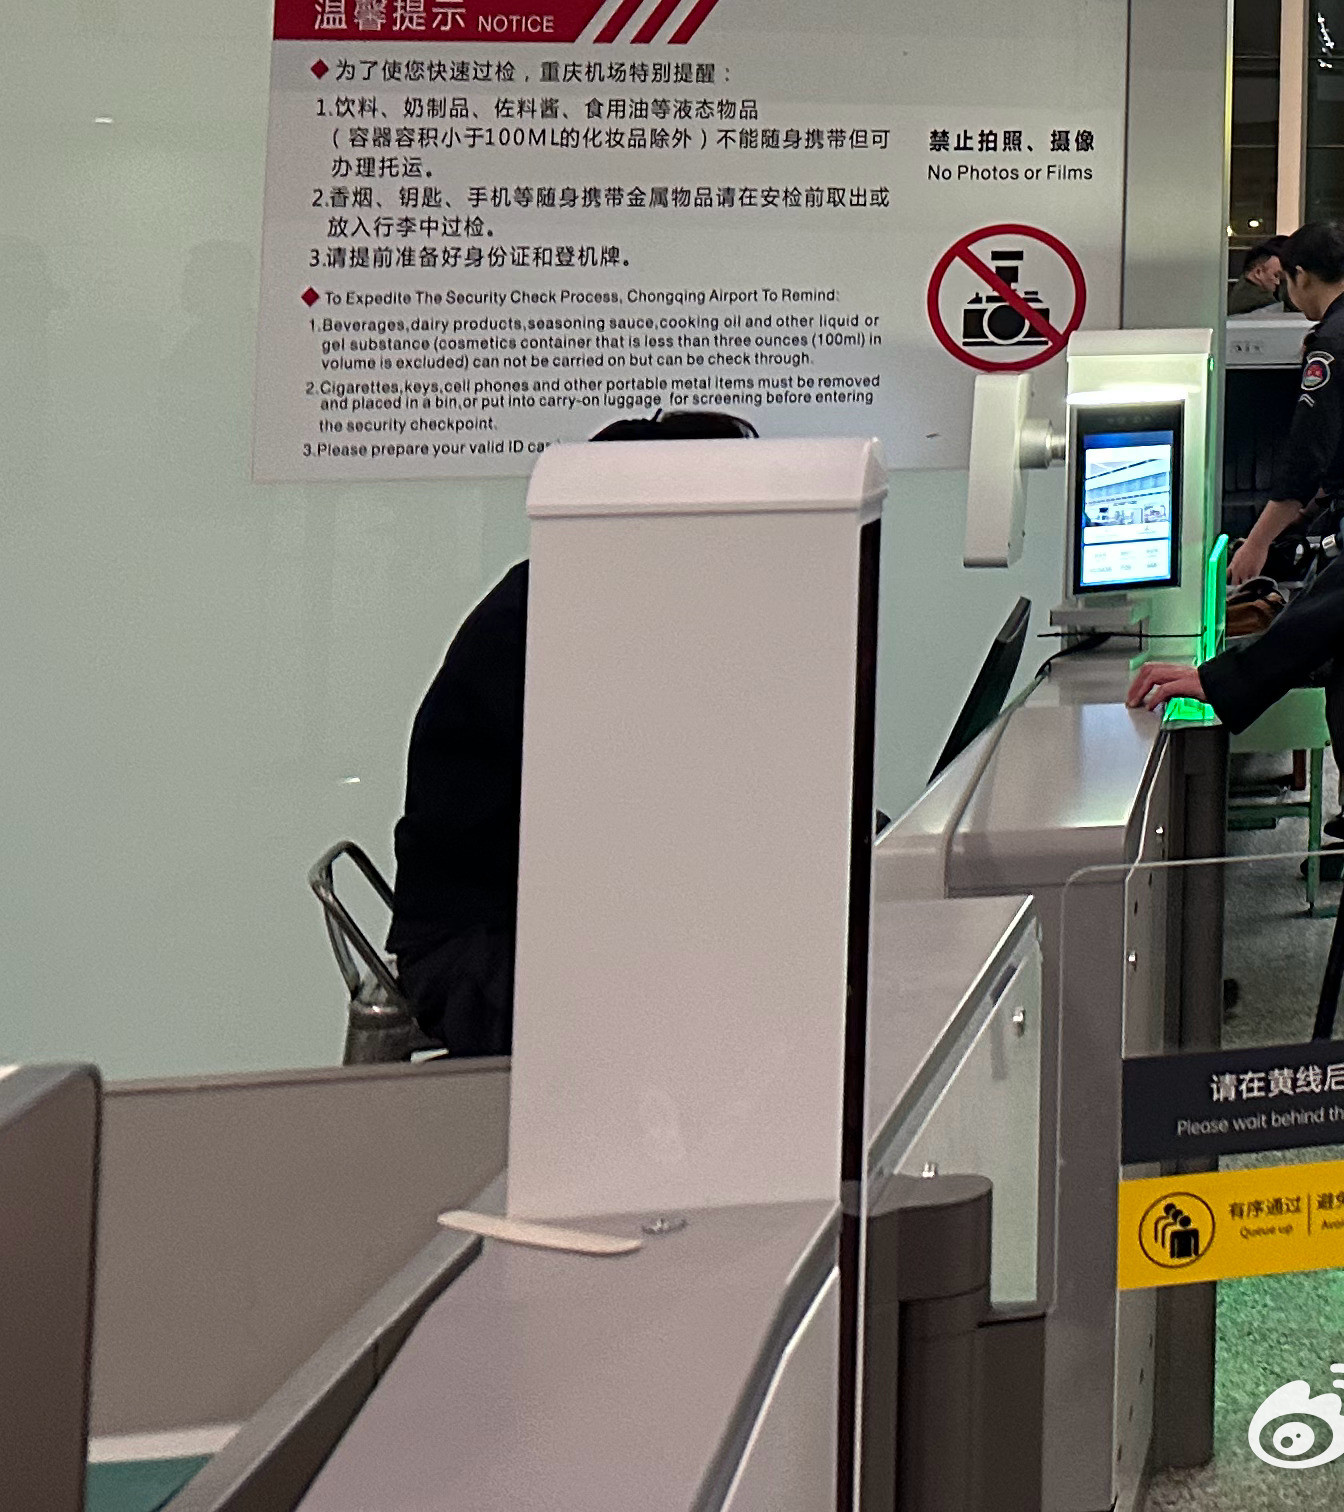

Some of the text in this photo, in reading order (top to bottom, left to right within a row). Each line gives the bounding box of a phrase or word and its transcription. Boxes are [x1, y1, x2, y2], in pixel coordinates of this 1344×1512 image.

[478, 15, 554, 33] NOTICE
[929, 129, 1094, 152] 禁止拍照、摄像
[331, 156, 432, 178] 办理托运。
[928, 165, 1093, 180] No Photos or Films
[327, 216, 493, 238] 放入行李中过检。
[325, 291, 341, 304] To
[346, 291, 411, 307] Expedite
[414, 290, 442, 304] The
[446, 290, 506, 306] Security
[510, 290, 556, 303] Check
[560, 290, 622, 303] Process,
[627, 289, 705, 305] Chongqing
[708, 289, 758, 304] Airport
[761, 288, 777, 301] To
[723, 314, 740, 327] oil
[745, 314, 772, 328] and
[776, 315, 814, 327] other
[819, 314, 858, 329] liquid
[864, 316, 879, 326] or
[322, 332, 882, 354] gel substance (cosmetics container that is less than three ounces (100ml) in
[322, 357, 375, 370] volume
[380, 358, 392, 369] is
[396, 355, 468, 369] excluded)
[472, 357, 499, 368] can
[503, 355, 527, 368] not
[530, 354, 548, 367] be
[552, 354, 604, 367] carried
[606, 356, 625, 366] on
[630, 354, 652, 366] but
[656, 355, 682, 366] can
[686, 353, 704, 365] be
[708, 353, 750, 364] check
[473, 379, 529, 394] phones
[533, 378, 560, 391] and
[563, 378, 602, 391] other
[606, 377, 667, 392] portable
[671, 377, 711, 389] metal
[715, 376, 754, 389] items
[758, 376, 792, 388] must
[797, 375, 814, 388] be
[818, 375, 880, 387] removed
[320, 396, 347, 410] and
[352, 396, 401, 411] placed
[405, 395, 418, 408] in
[422, 395, 430, 408] a
[481, 394, 505, 410] put
[508, 394, 535, 407] into
[539, 396, 599, 408] carry-on
[604, 394, 661, 408] luggage
[670, 392, 688, 405] for
[692, 393, 762, 406] screening
[766, 391, 811, 403] before
[815, 390, 873, 404] entering
[319, 419, 342, 432] the
[346, 418, 406, 433] security
[371, 444, 428, 457] prepare
[432, 443, 466, 456] your
[469, 440, 504, 453] valid
[508, 439, 523, 453] ID
[1177, 1120, 1229, 1137] Please
[1233, 1115, 1267, 1131] wait
[1271, 1107, 1324, 1127] behind
[1229, 1196, 1302, 1221] 有序通过
